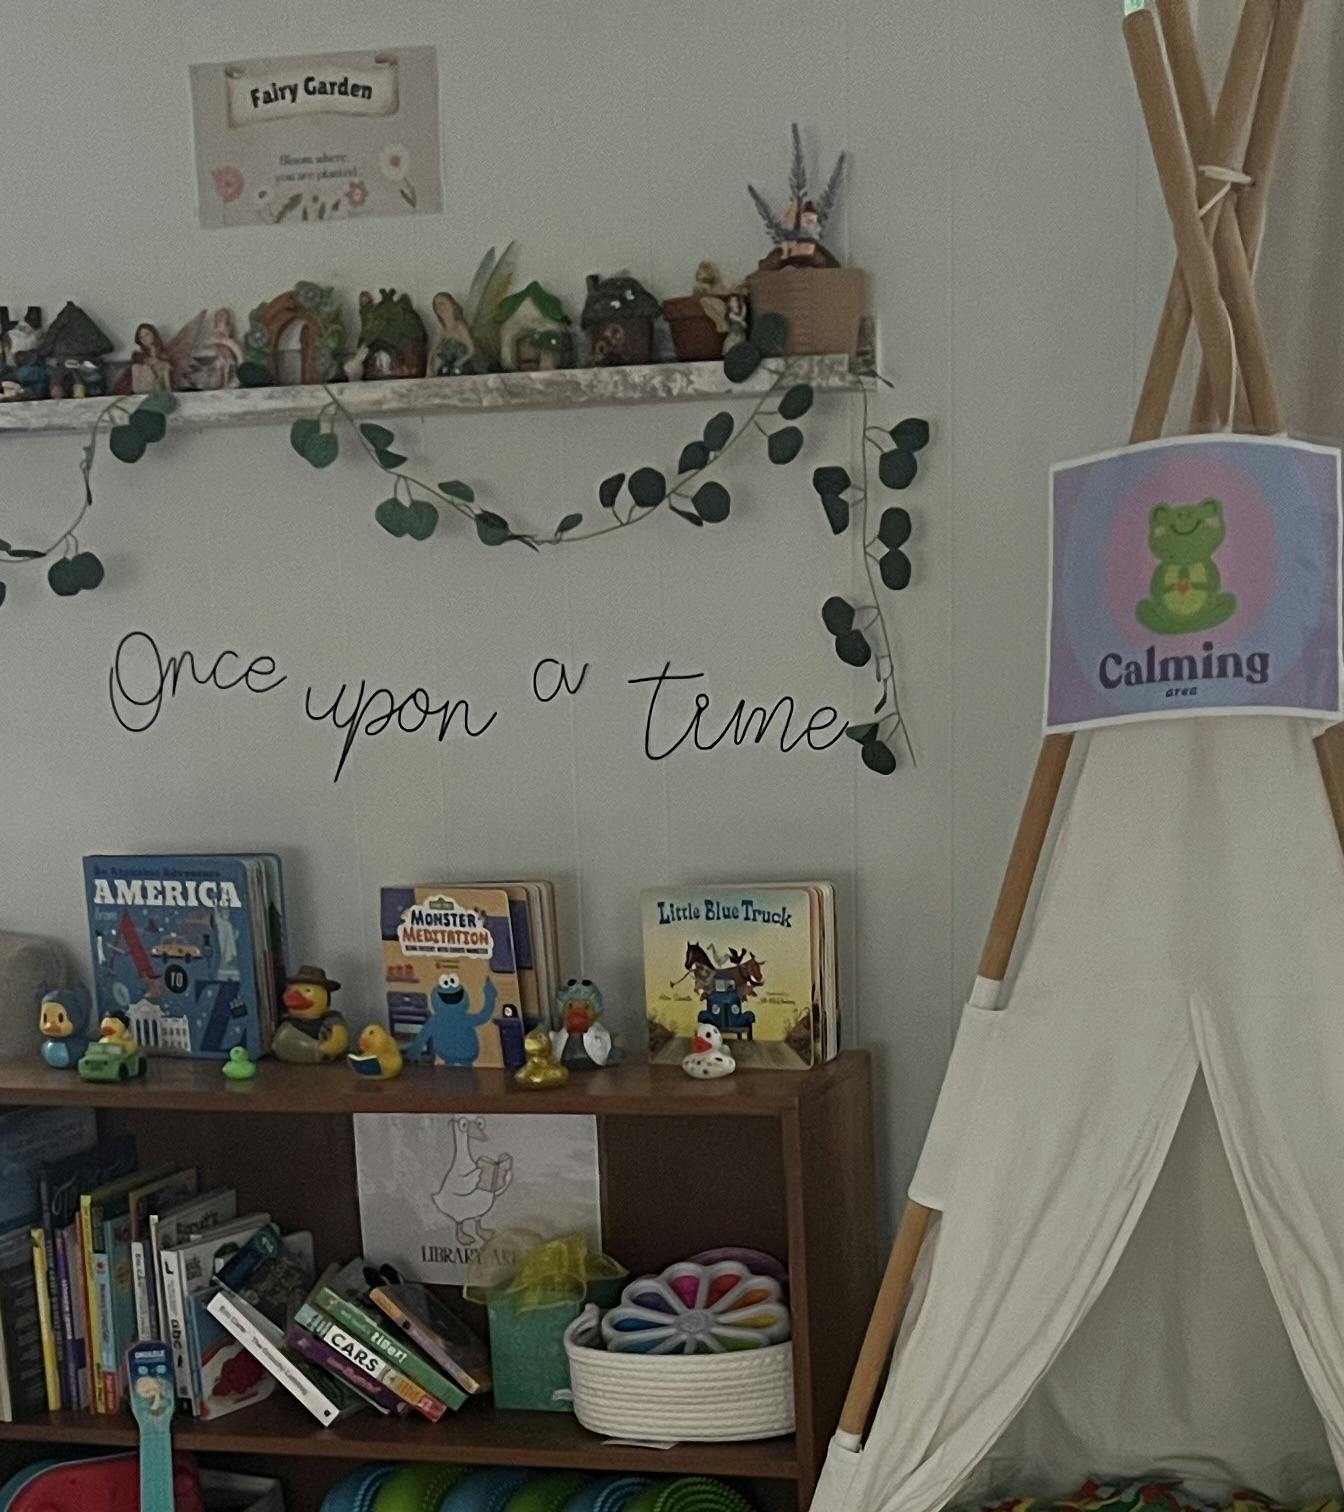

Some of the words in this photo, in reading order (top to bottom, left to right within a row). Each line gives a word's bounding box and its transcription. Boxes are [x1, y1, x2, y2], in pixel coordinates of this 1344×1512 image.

[250, 82, 299, 109] Fairy
[304, 76, 373, 100] Garden
[1098, 641, 1271, 690] Calming
[1165, 685, 1199, 699] area
[108, 631, 288, 732] Once
[304, 679, 498, 784] upon
[532, 656, 589, 703] a
[628, 660, 849, 761] time
[93, 878, 242, 908] AMERICA
[410, 909, 477, 928] MONSTER
[657, 901, 700, 925] Little
[703, 899, 739, 921] Blue
[741, 899, 793, 928] Truck
[402, 926, 490, 946] MEDITATION
[169, 970, 184, 988] TO
[421, 1245, 481, 1265] LIBRARY
[170, 1319, 183, 1351] abc
[331, 1333, 380, 1373] CARS
